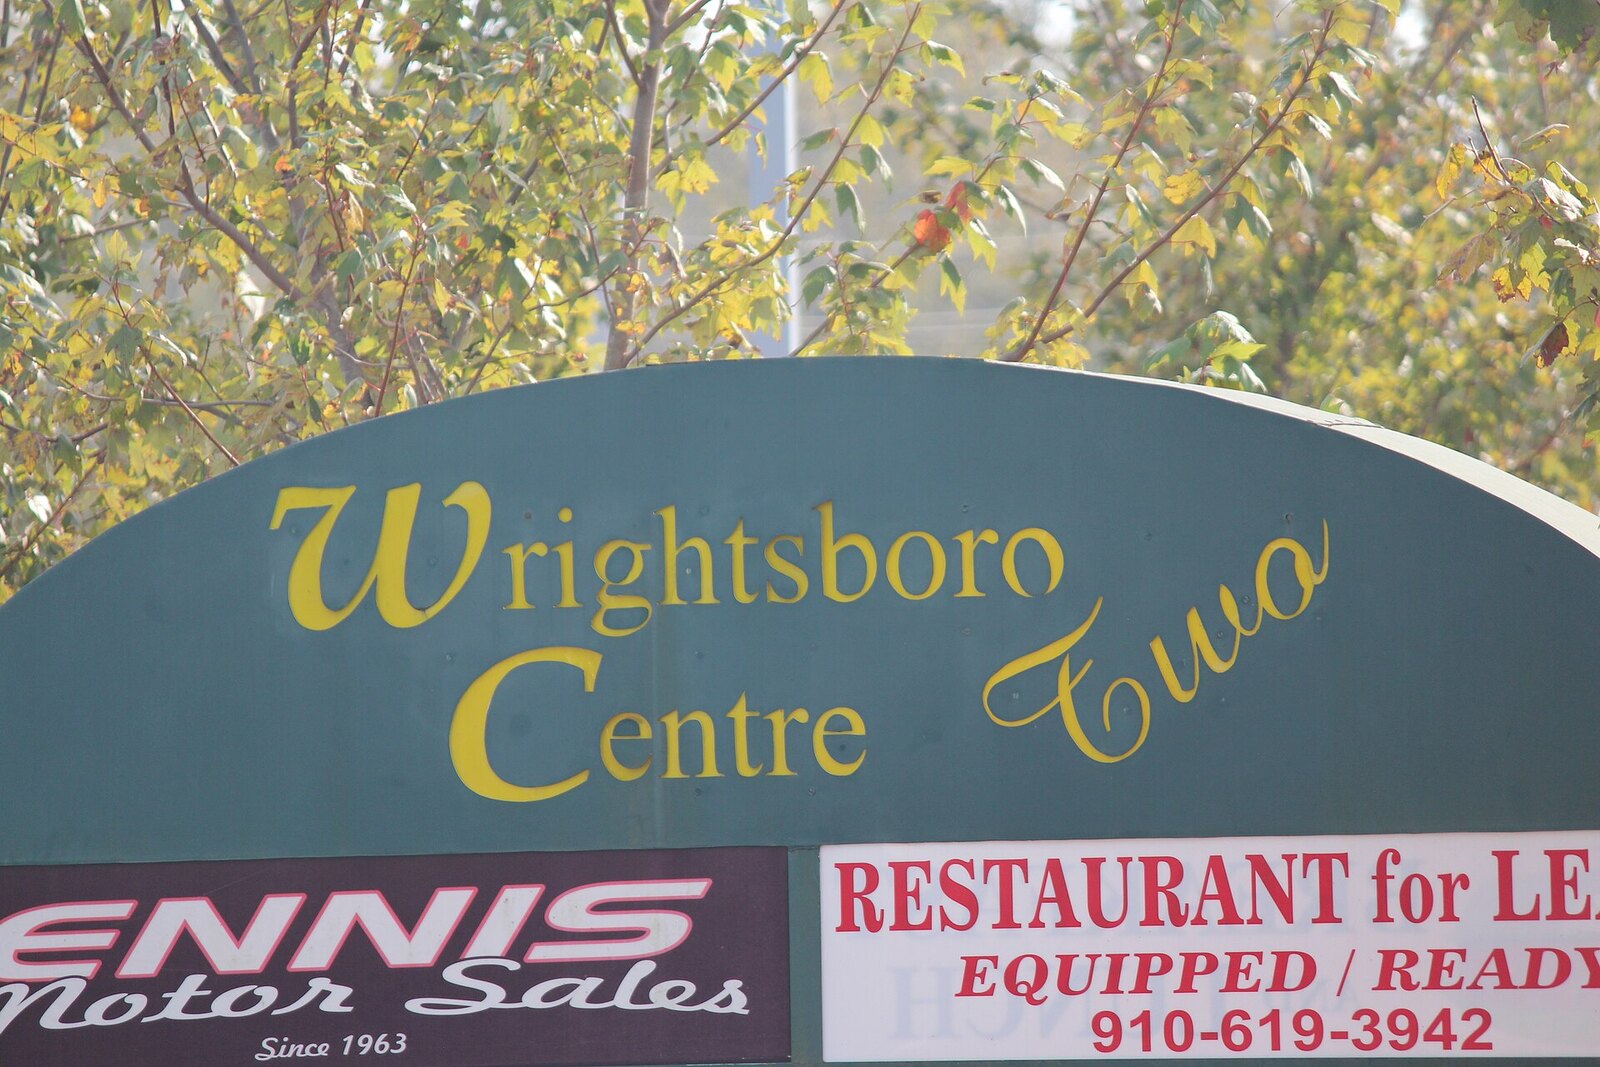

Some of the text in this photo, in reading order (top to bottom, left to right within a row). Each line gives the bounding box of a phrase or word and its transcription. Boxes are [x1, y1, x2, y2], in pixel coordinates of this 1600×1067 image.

[269, 481, 1065, 637] Wrightsboro
[982, 518, 1330, 764] Two
[449, 646, 867, 803] Centre
[833, 852, 1350, 934] RESTAURANT
[1371, 847, 1471, 925] for
[1491, 848, 1600, 923] LE
[404, 957, 750, 1016] Sales
[954, 950, 1318, 1006] EQUIPPED
[1372, 946, 1600, 992] READY
[254, 1032, 407, 1061] Since 1963
[1091, 1007, 1494, 1054] 910-619-3942
